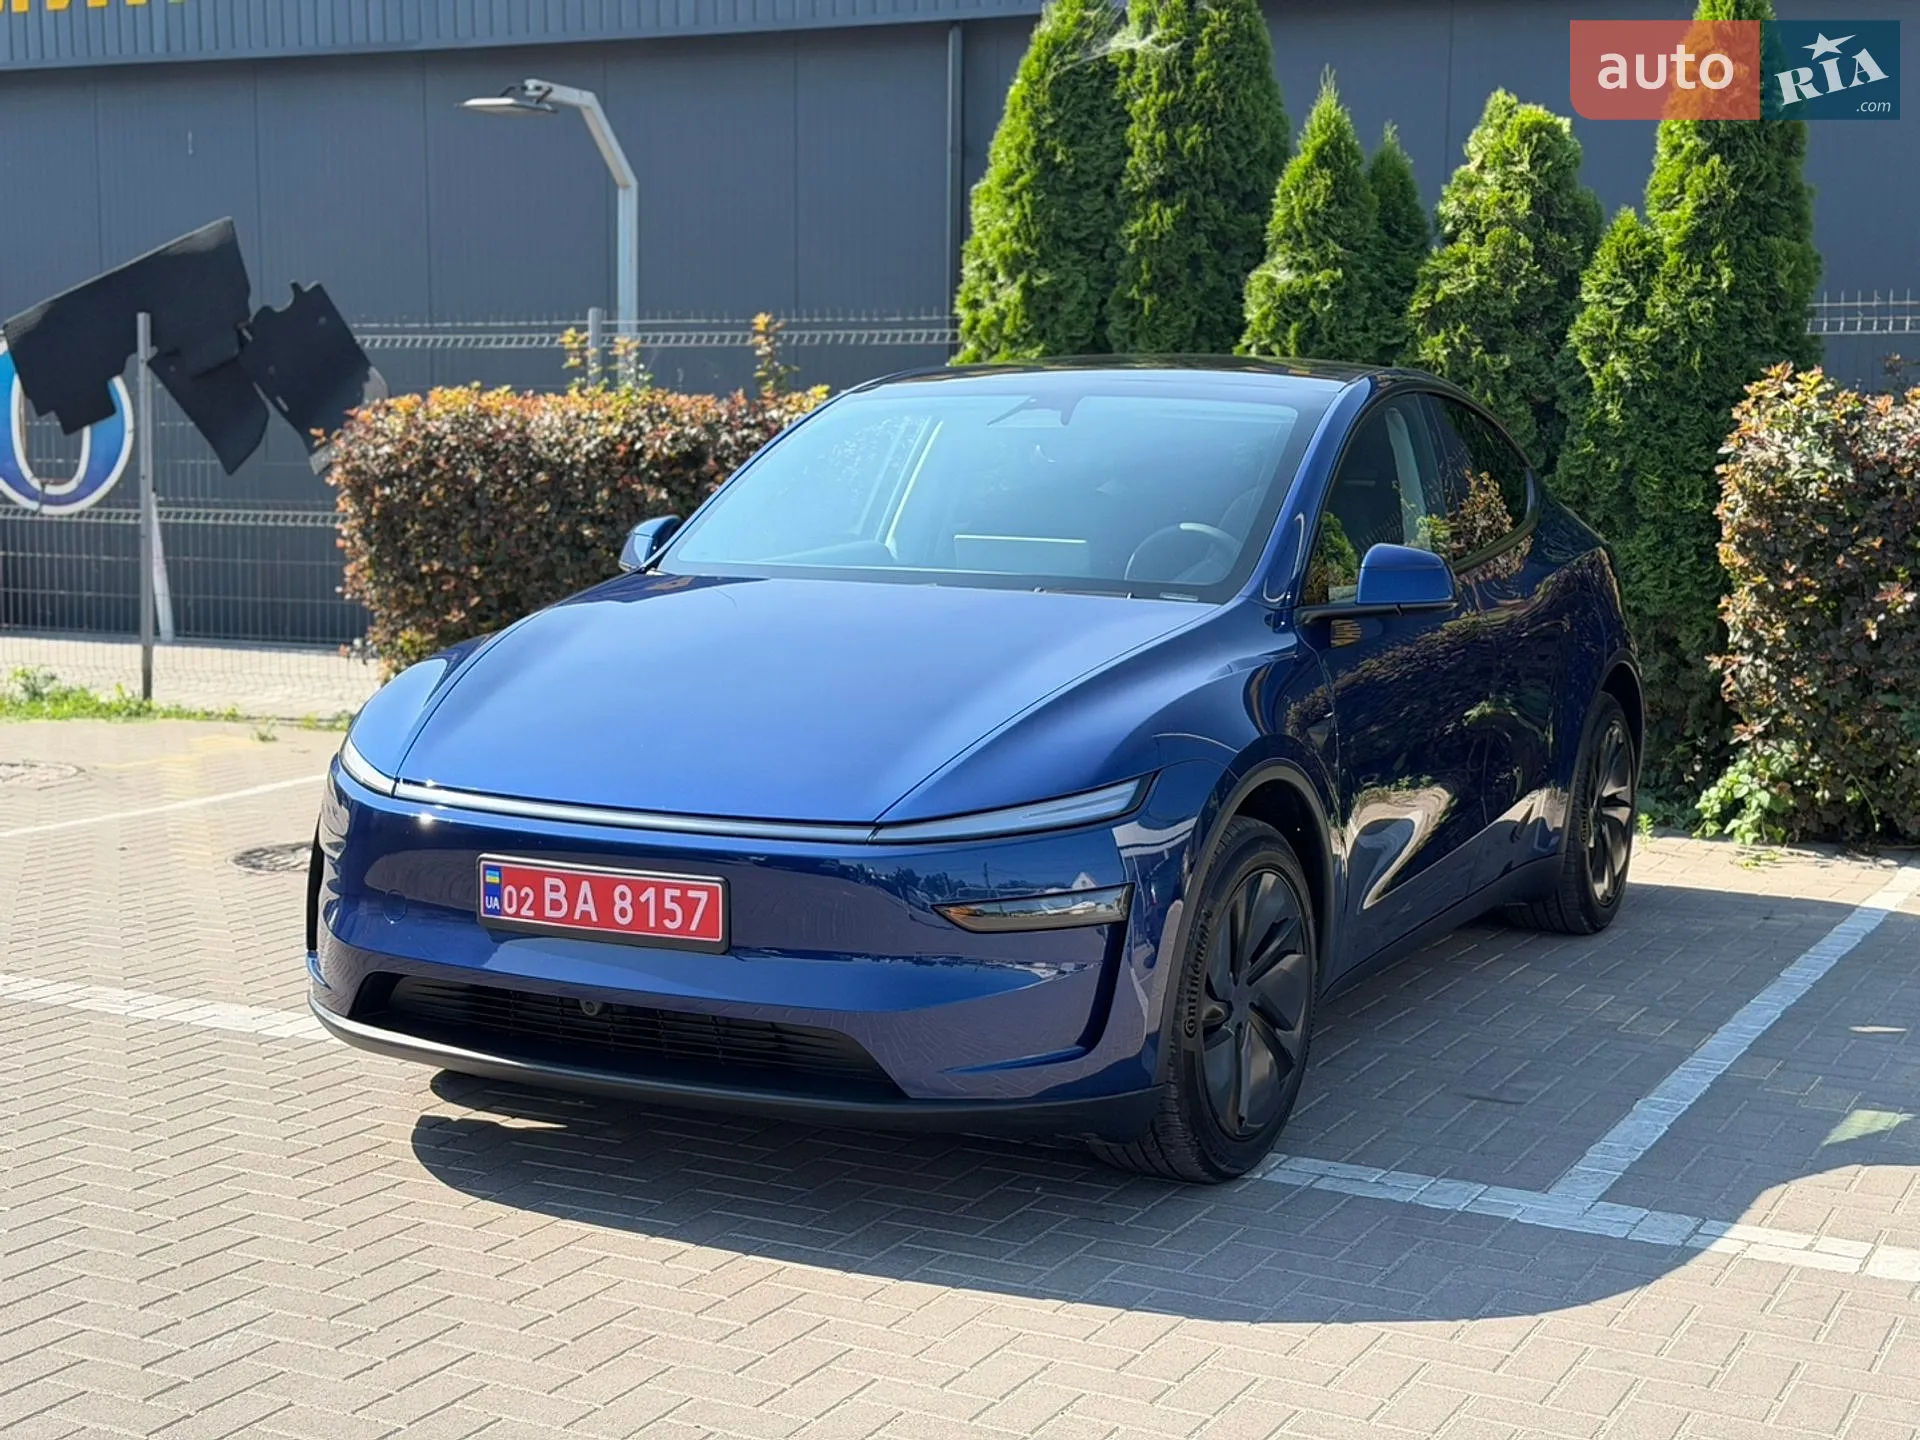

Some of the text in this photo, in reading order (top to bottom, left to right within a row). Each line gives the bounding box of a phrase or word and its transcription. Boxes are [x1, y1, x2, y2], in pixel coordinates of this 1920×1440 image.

[486, 895, 501, 911] UA
[503, 877, 709, 932] 02 BA 8157
